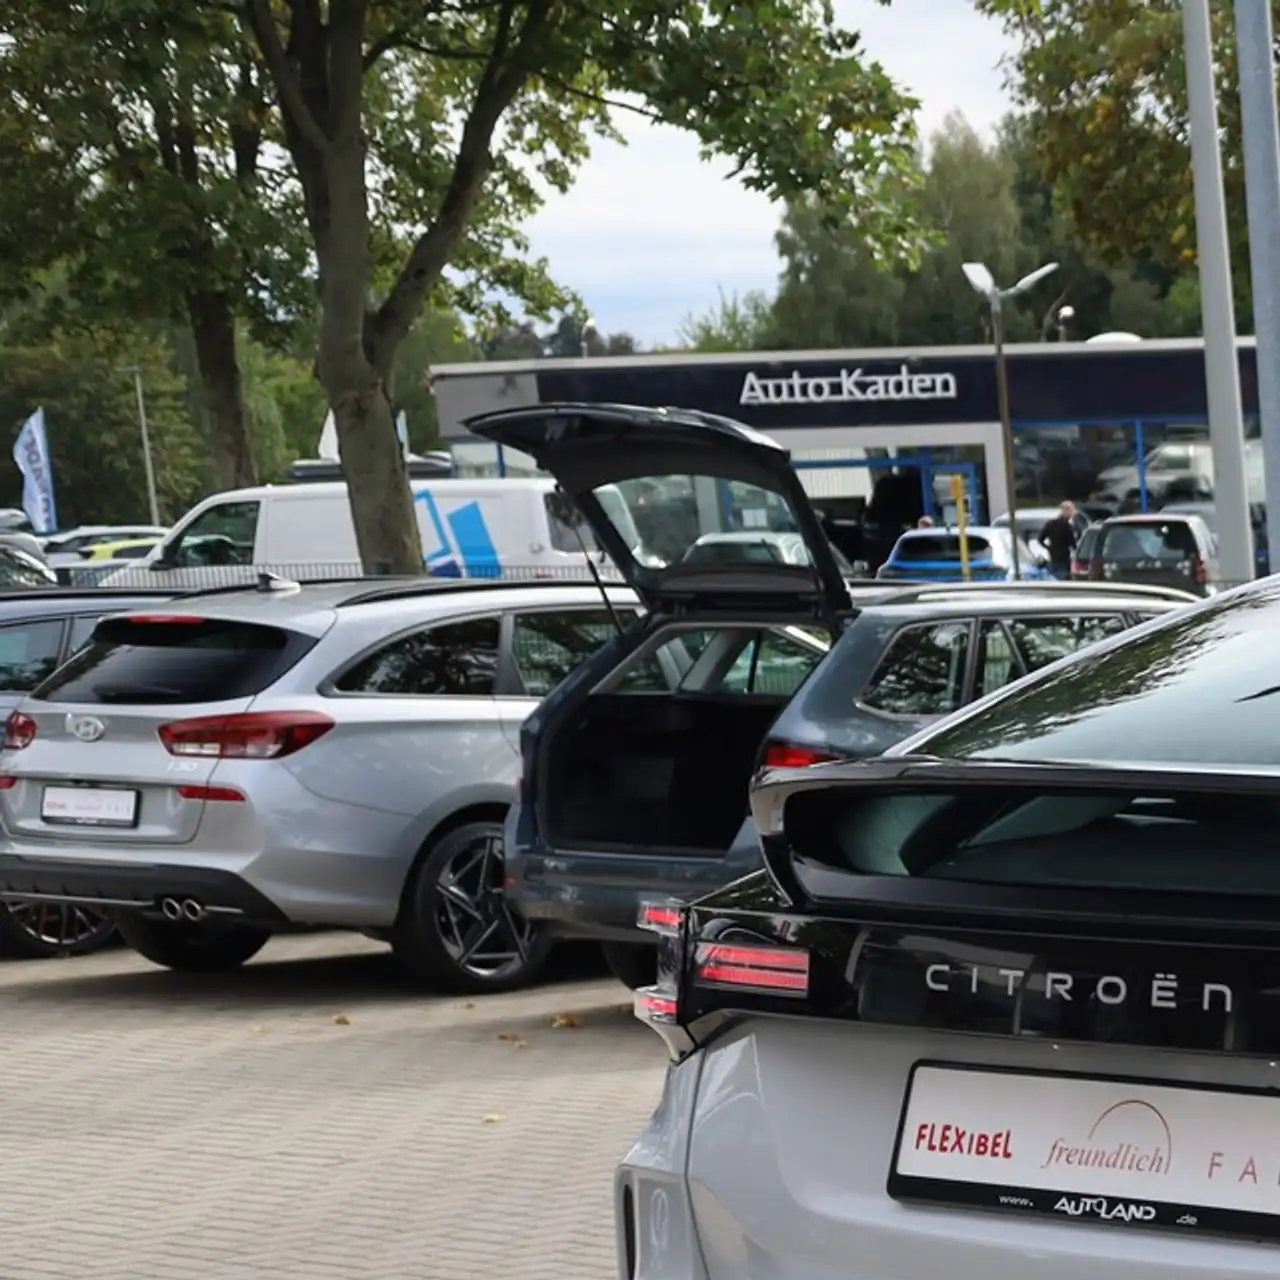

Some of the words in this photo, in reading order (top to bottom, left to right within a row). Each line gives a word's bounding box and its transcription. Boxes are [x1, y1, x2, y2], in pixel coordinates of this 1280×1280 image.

[740, 370, 830, 405] Auto
[840, 364, 957, 400] Kaden
[915, 1123, 1013, 1160] FLEXIBEL
[1040, 1138, 1164, 1174] freundlich
